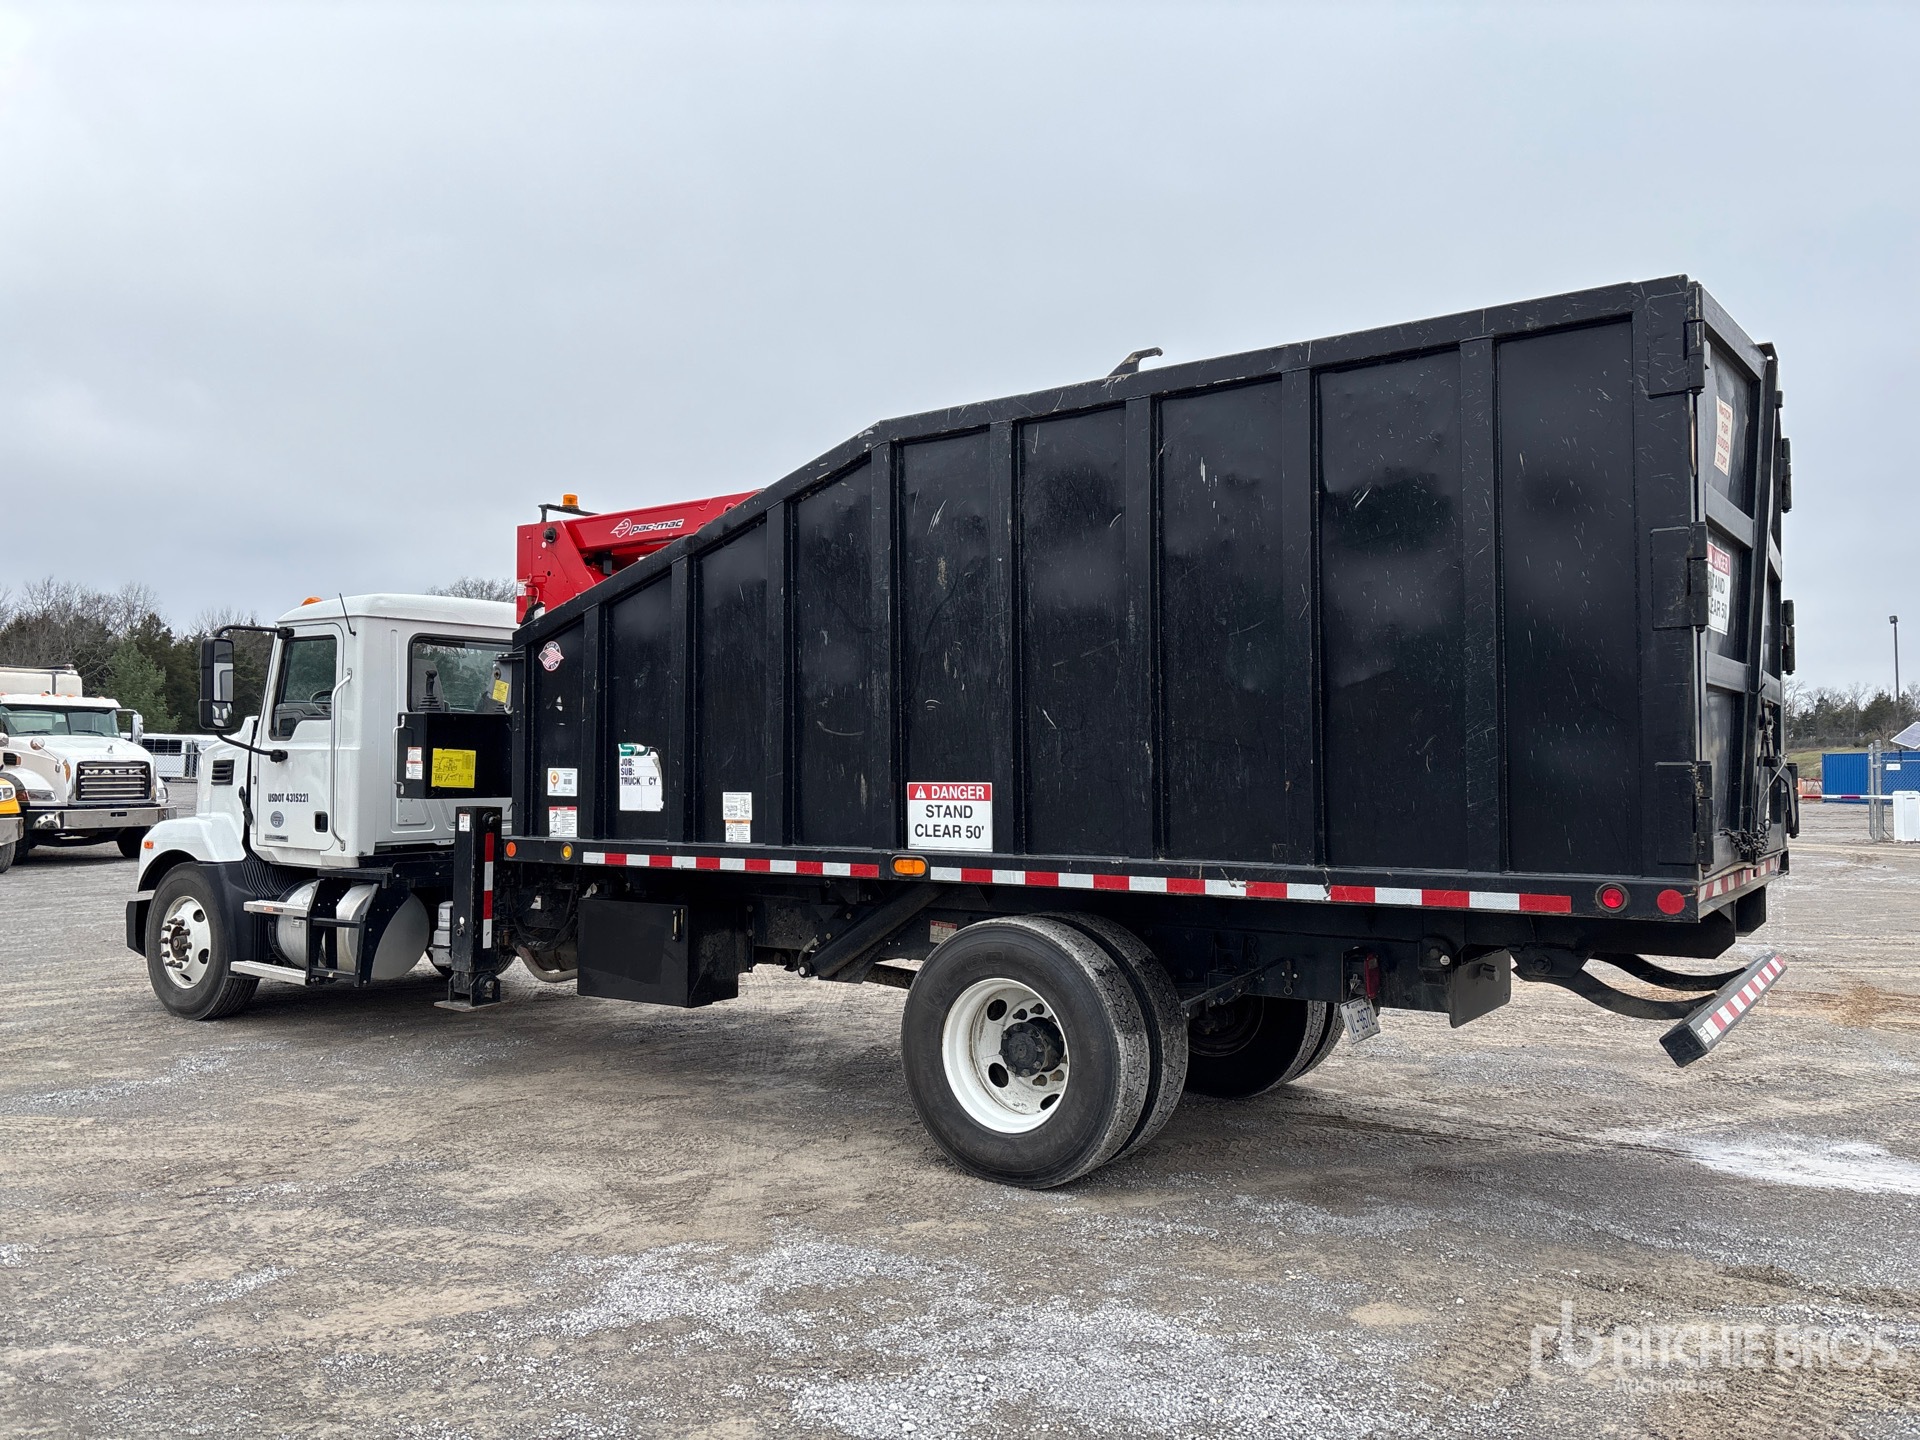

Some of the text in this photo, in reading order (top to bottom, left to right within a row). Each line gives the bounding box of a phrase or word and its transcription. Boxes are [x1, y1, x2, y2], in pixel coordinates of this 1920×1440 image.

[630, 519, 684, 535] pac-mac
[620, 758, 635, 767] JOB:
[620, 767, 635, 776] SUB:
[620, 777, 657, 786] TRUCK CY
[267, 793, 309, 803] USDOT 4315221
[931, 785, 985, 800] DANGER
[925, 804, 973, 819] STAND
[914, 823, 984, 839] CLEAR 50'
